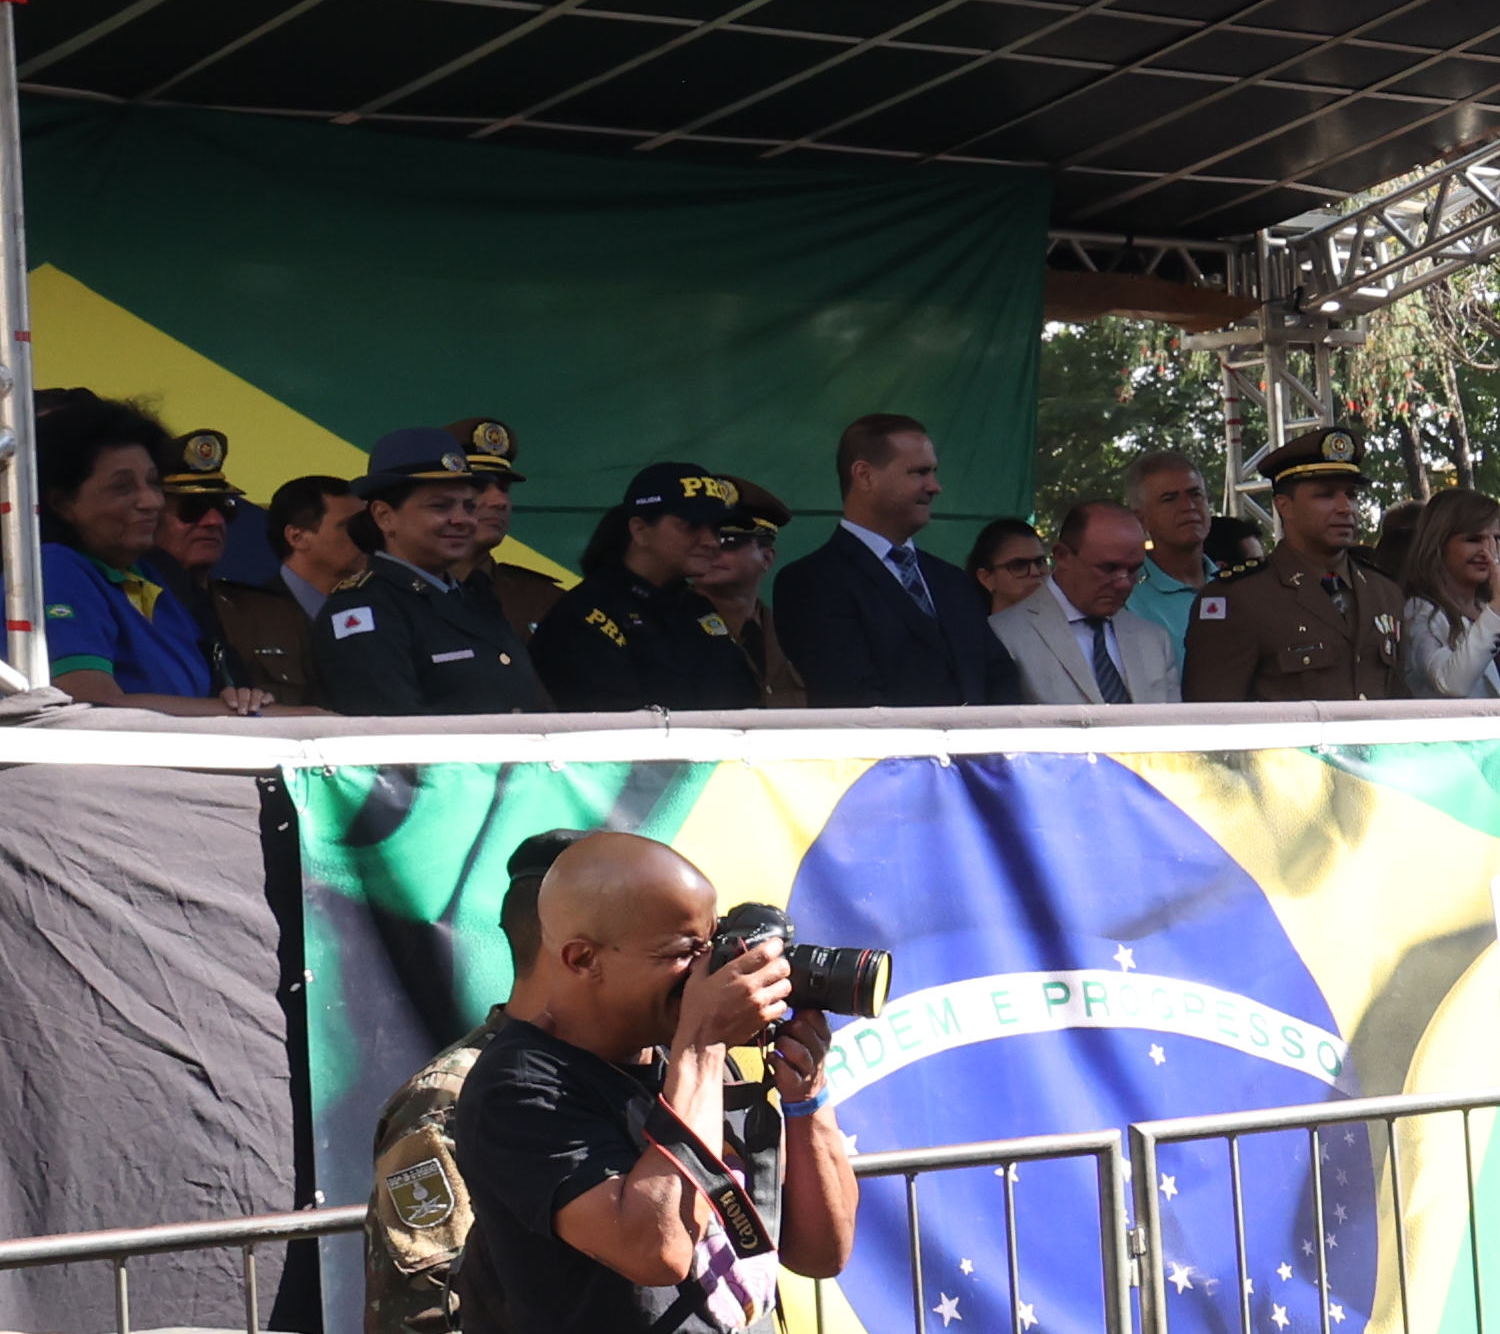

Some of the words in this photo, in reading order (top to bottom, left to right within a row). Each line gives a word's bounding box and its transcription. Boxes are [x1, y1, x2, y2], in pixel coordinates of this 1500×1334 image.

[825, 995, 962, 1090] RDEM
[993, 993, 1021, 1024] E
[720, 1190, 759, 1250] Canon
